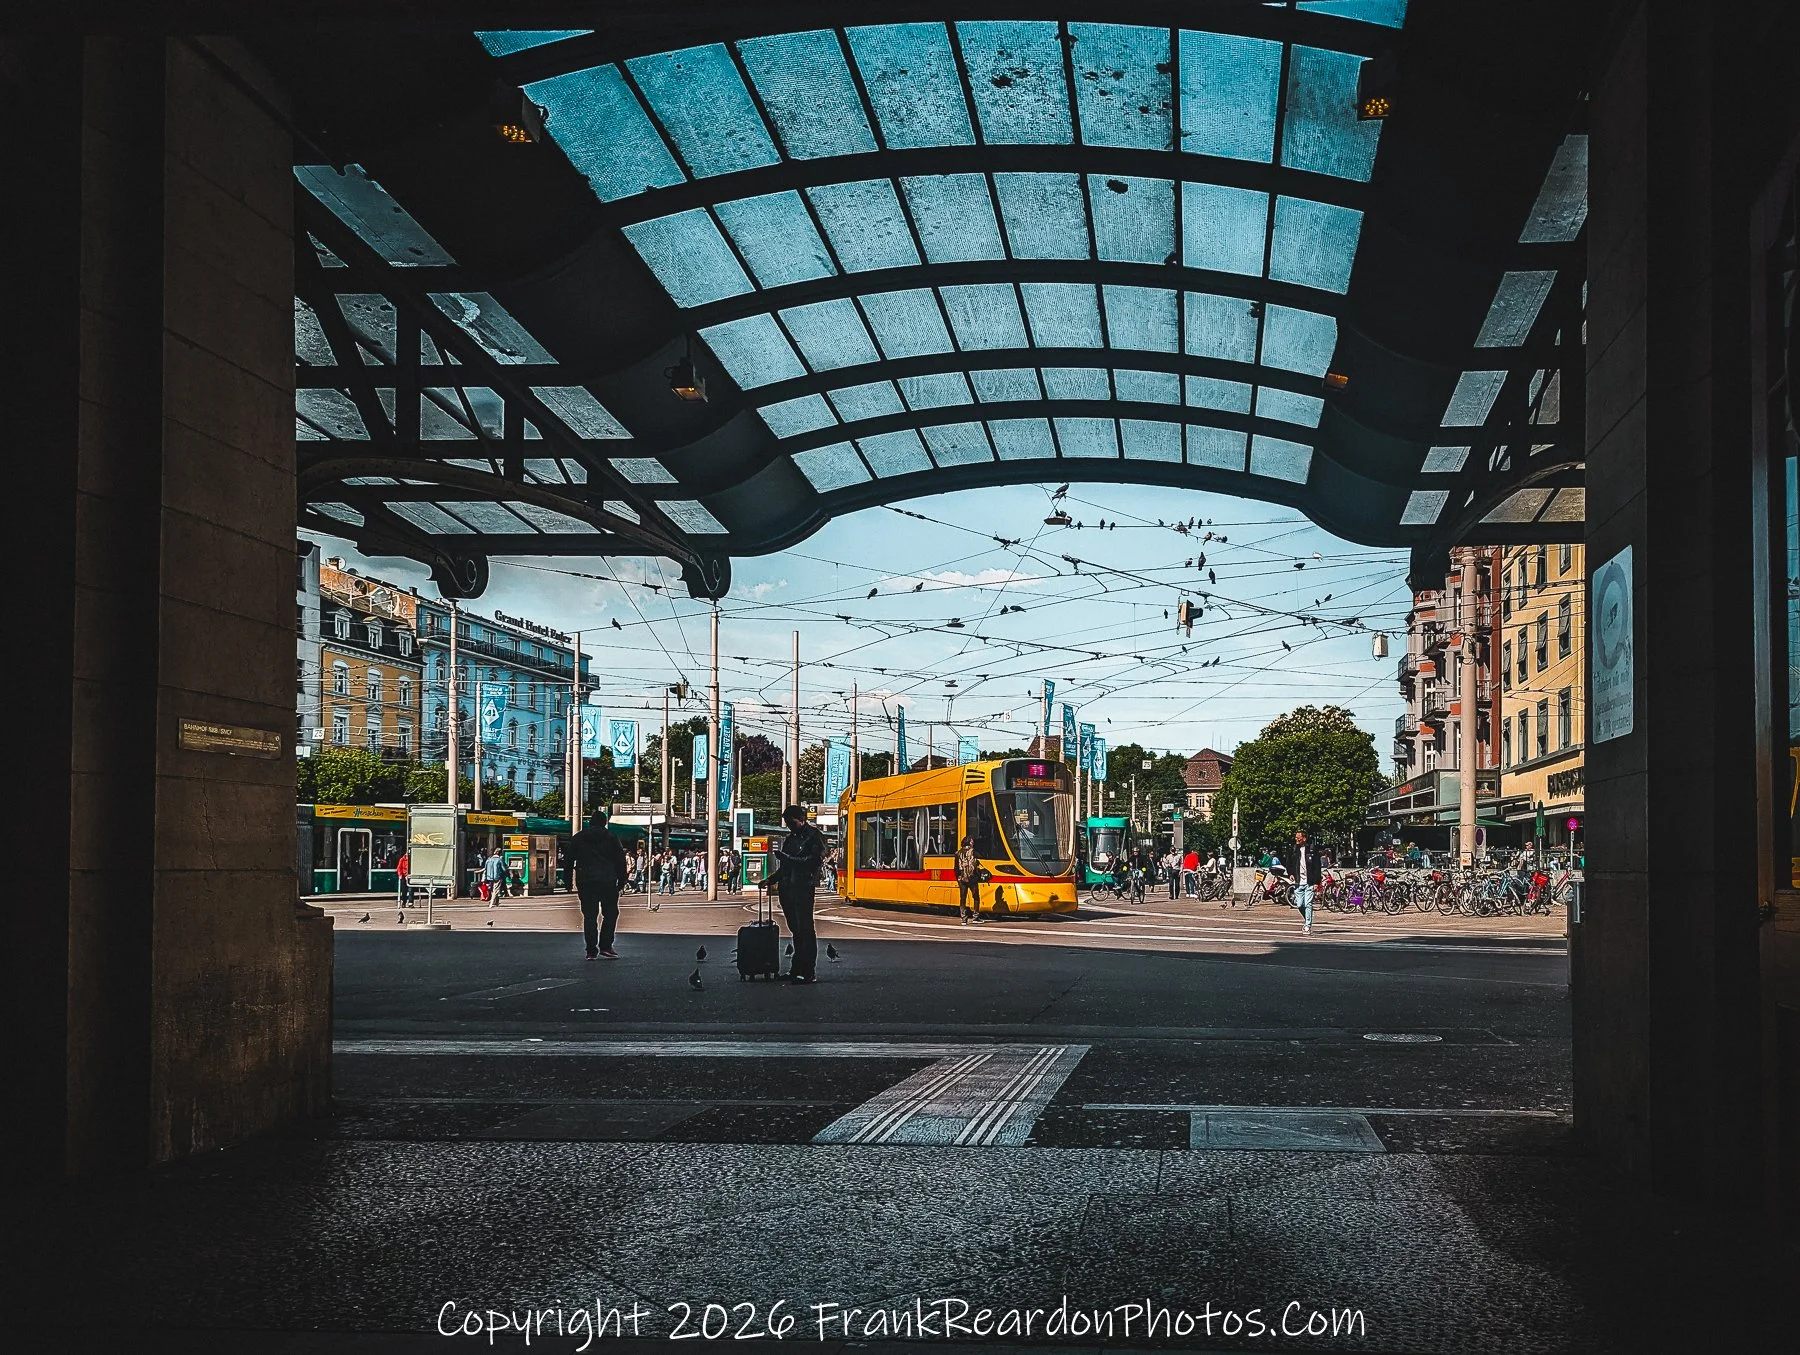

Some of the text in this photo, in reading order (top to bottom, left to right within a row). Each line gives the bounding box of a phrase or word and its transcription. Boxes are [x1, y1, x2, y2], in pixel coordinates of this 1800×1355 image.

[495, 609, 525, 629] Grand
[525, 620, 549, 637] Hotel
[314, 729, 323, 738] 25
[830, 773, 838, 799] FANTASY
